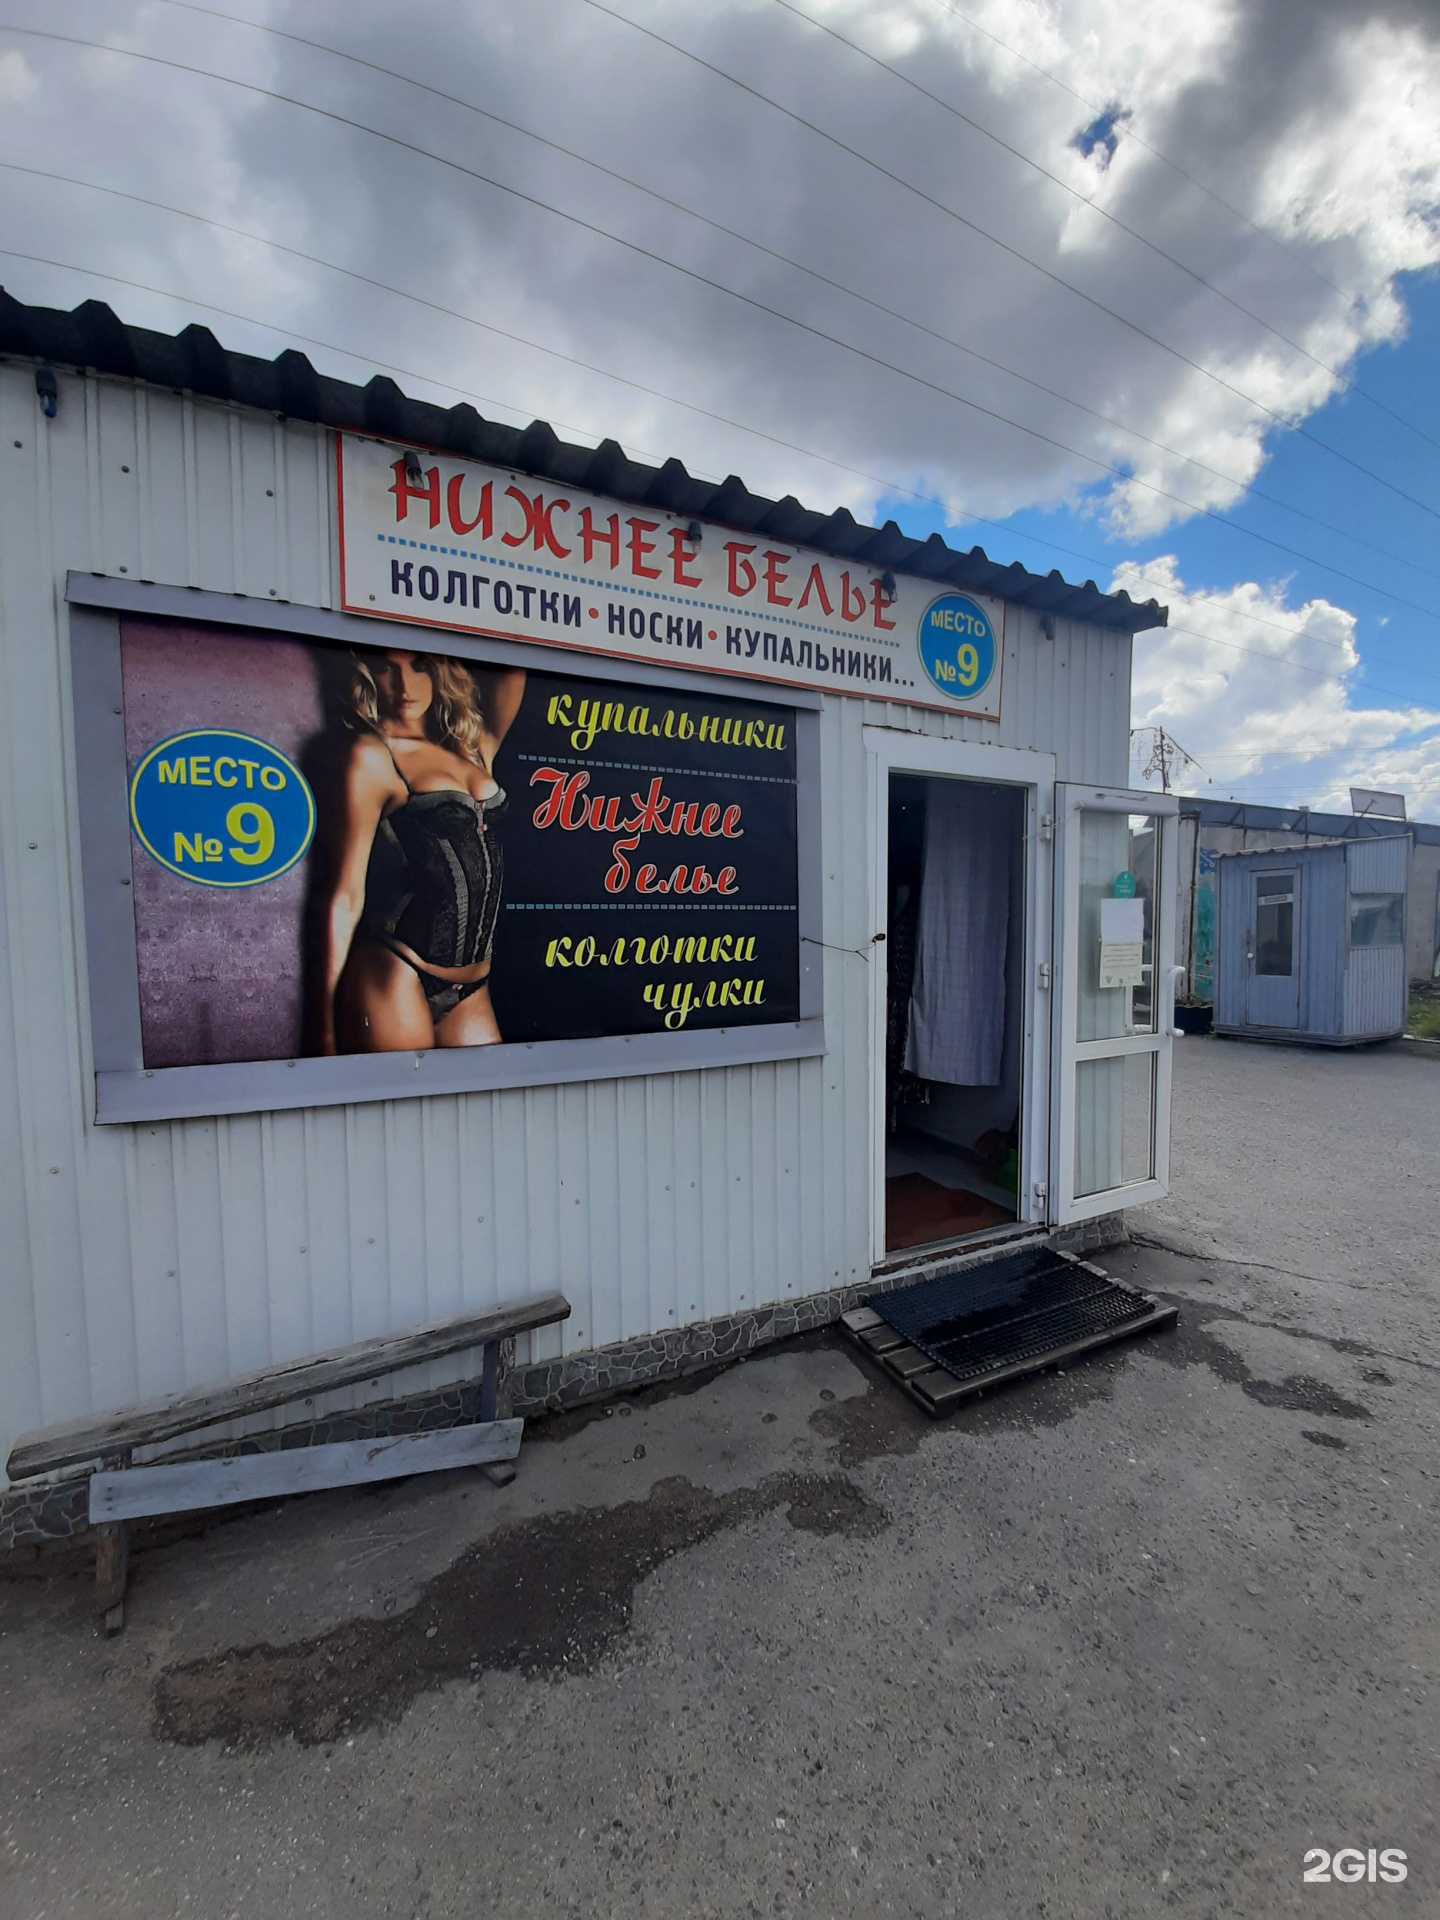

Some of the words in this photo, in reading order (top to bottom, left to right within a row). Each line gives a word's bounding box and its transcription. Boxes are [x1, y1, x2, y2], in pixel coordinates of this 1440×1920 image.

[388, 459, 703, 587] НИЖНЕЕ
[724, 542, 897, 630] БЕЛЬЕ
[390, 559, 582, 628] КОЛГОТКИ
[608, 603, 703, 649] НОСКИ
[726, 625, 915, 688] КУПАЛЬНИКИ...
[931, 608, 986, 638] МЕСТО
[547, 693, 787, 751] купальники
[158, 757, 287, 791] МЕСТО
[530, 767, 744, 838] Нижнее
[605, 831, 739, 894] белье
[545, 934, 758, 968] колготки
[643, 978, 766, 1029] чулки
